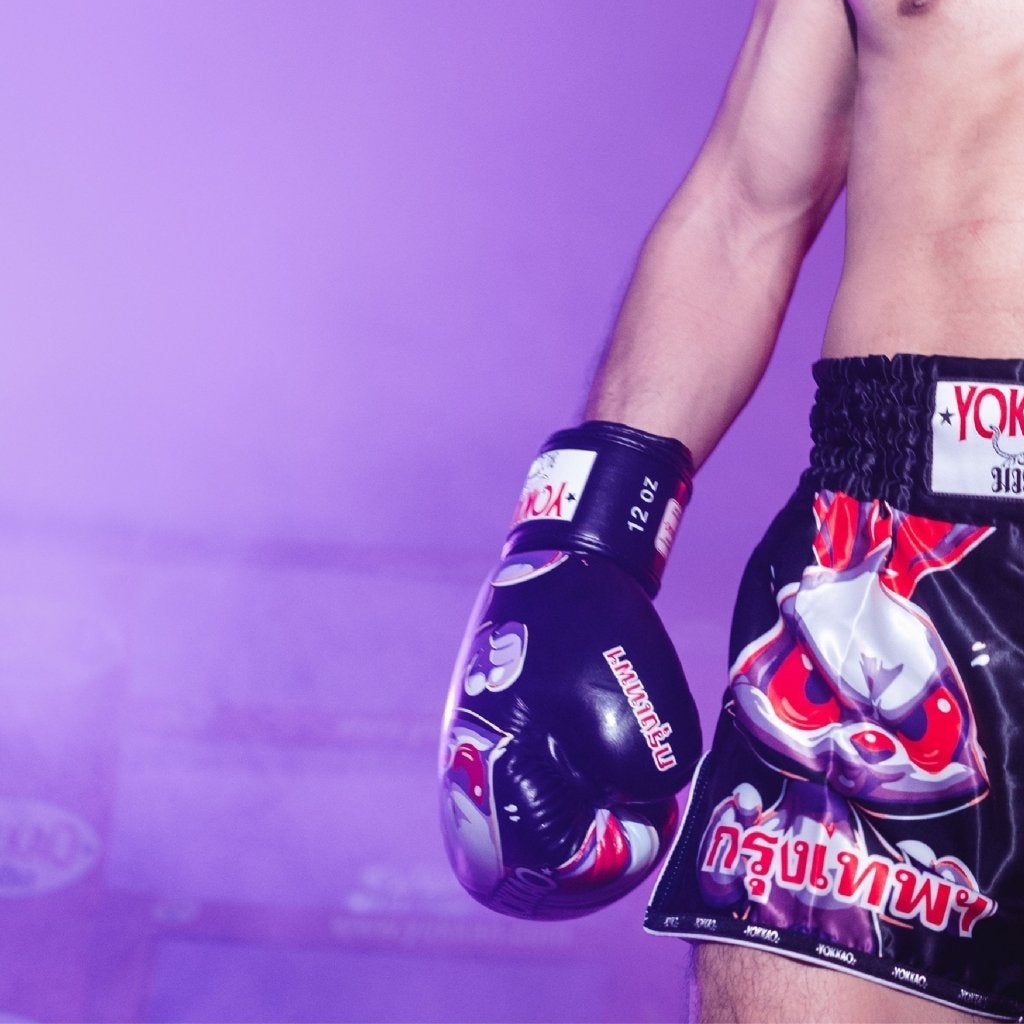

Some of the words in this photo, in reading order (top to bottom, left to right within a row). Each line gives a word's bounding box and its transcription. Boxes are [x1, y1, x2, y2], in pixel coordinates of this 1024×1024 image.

[627, 506, 649, 532] 12
[703, 824, 994, 936] กรุงเทพฯ
